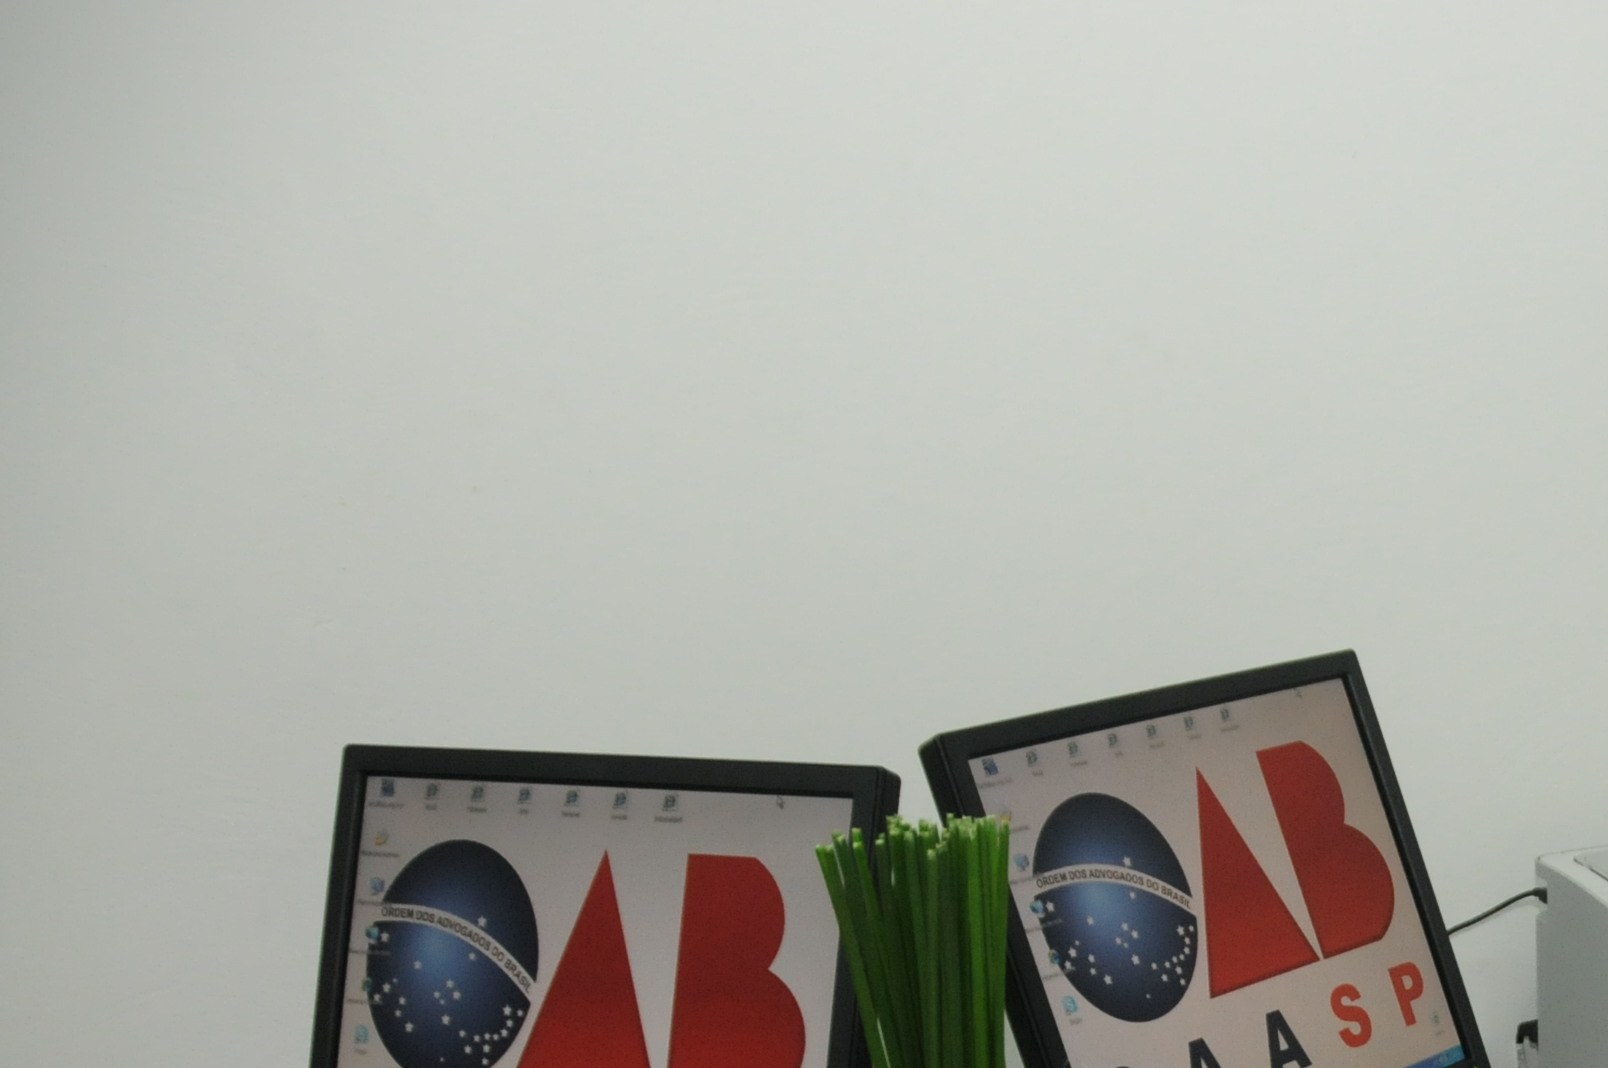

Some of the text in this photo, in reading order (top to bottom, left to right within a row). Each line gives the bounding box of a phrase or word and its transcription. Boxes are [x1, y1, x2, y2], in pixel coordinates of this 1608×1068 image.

[1032, 739, 1395, 1023] OAB
[1036, 869, 1191, 909] ORDEM DOS ADVOGADOS DO BRASIL
[381, 905, 532, 994] ORDEM DOS ADVOGADOS DO BRASIL
